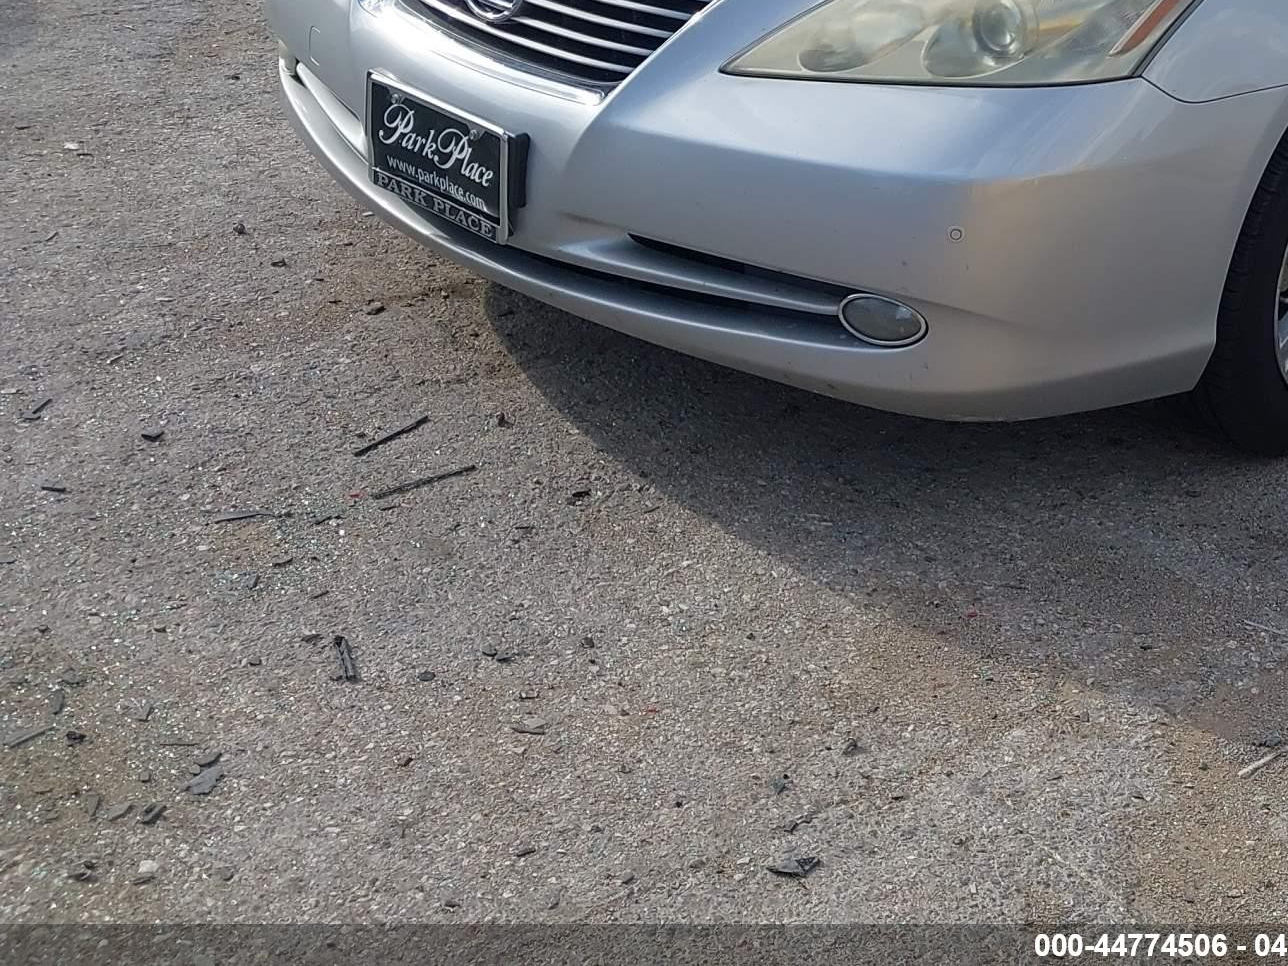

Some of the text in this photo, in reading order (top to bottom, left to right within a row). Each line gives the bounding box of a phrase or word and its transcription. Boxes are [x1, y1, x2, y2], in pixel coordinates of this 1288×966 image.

[377, 172, 493, 238] PARK PLACE
[387, 155, 487, 211] www.parkplace.com
